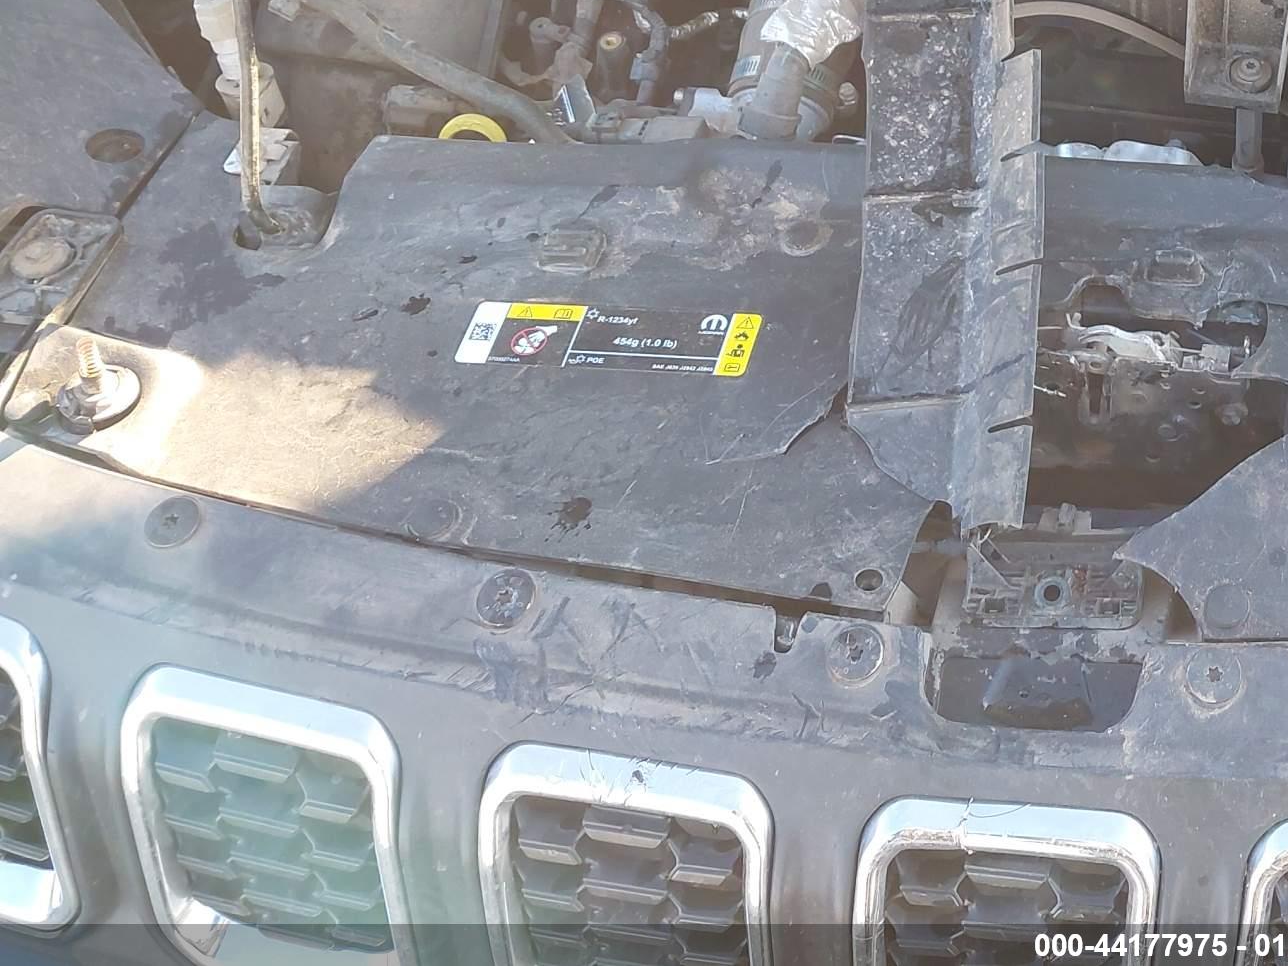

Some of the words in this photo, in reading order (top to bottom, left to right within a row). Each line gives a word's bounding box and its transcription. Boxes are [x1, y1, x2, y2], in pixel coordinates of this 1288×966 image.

[597, 315, 639, 325] R-1234yf
[613, 337, 639, 348] 454g
[641, 338, 661, 348] (1.0
[662, 339, 677, 350] lb)
